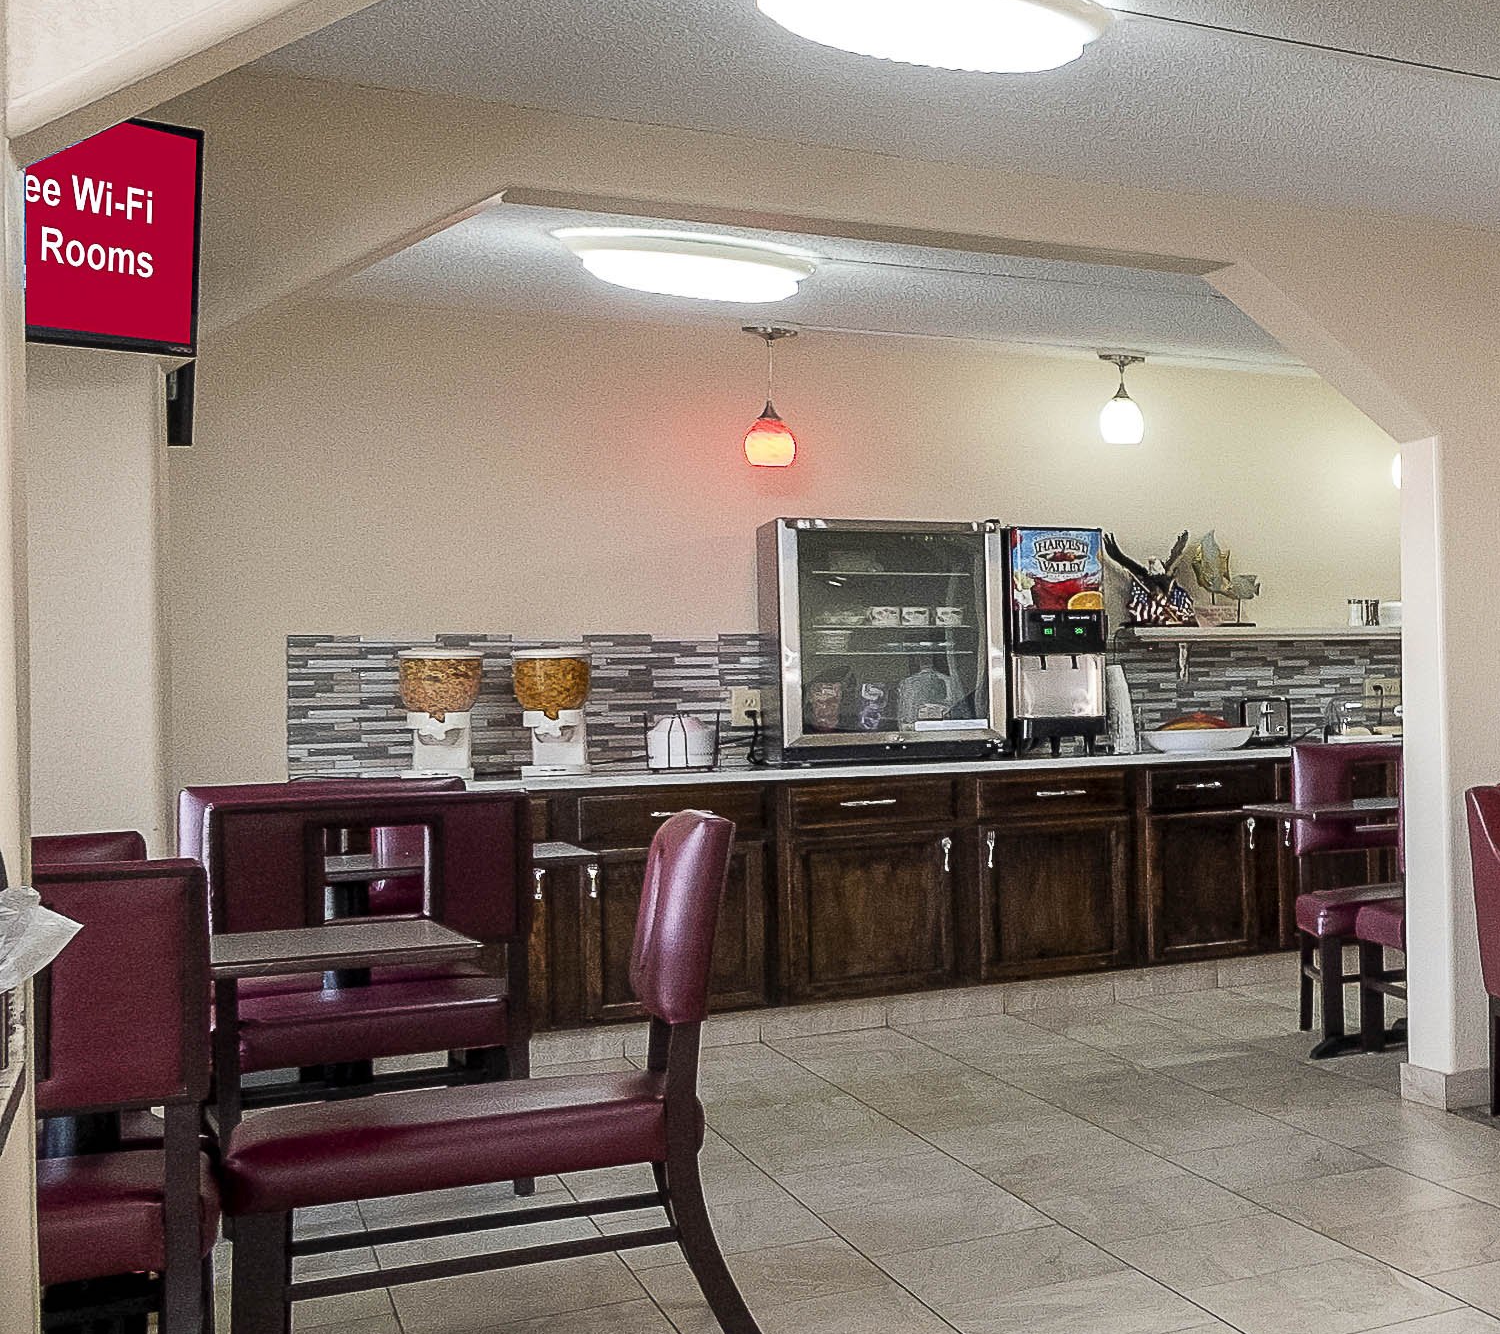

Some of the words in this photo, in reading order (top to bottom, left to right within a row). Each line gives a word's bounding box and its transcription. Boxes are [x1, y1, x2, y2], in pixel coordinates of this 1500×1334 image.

[25, 174, 61, 207] ee
[72, 175, 153, 224] Wi-Fi
[41, 226, 154, 278] Rooms
[1036, 538, 1087, 554] HARVEST
[1042, 560, 1083, 573] VALLEY
